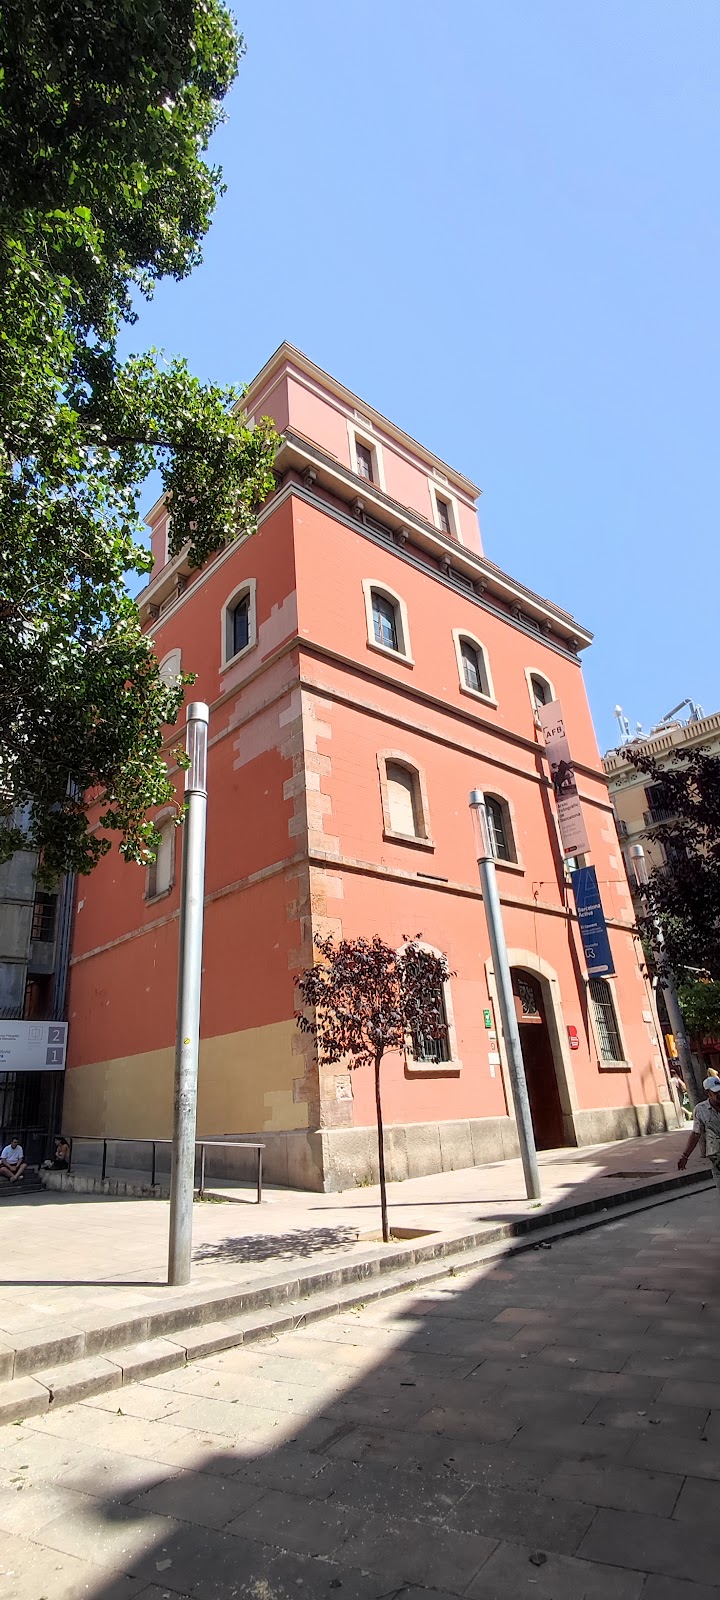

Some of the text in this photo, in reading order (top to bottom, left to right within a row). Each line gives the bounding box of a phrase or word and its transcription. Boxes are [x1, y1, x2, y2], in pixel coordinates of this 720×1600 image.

[546, 726, 562, 739] AFB
[560, 812, 581, 823] Barcelona
[577, 904, 600, 913] Barcelona
[52, 1029, 60, 1042] 2
[51, 1050, 58, 1062] 1
